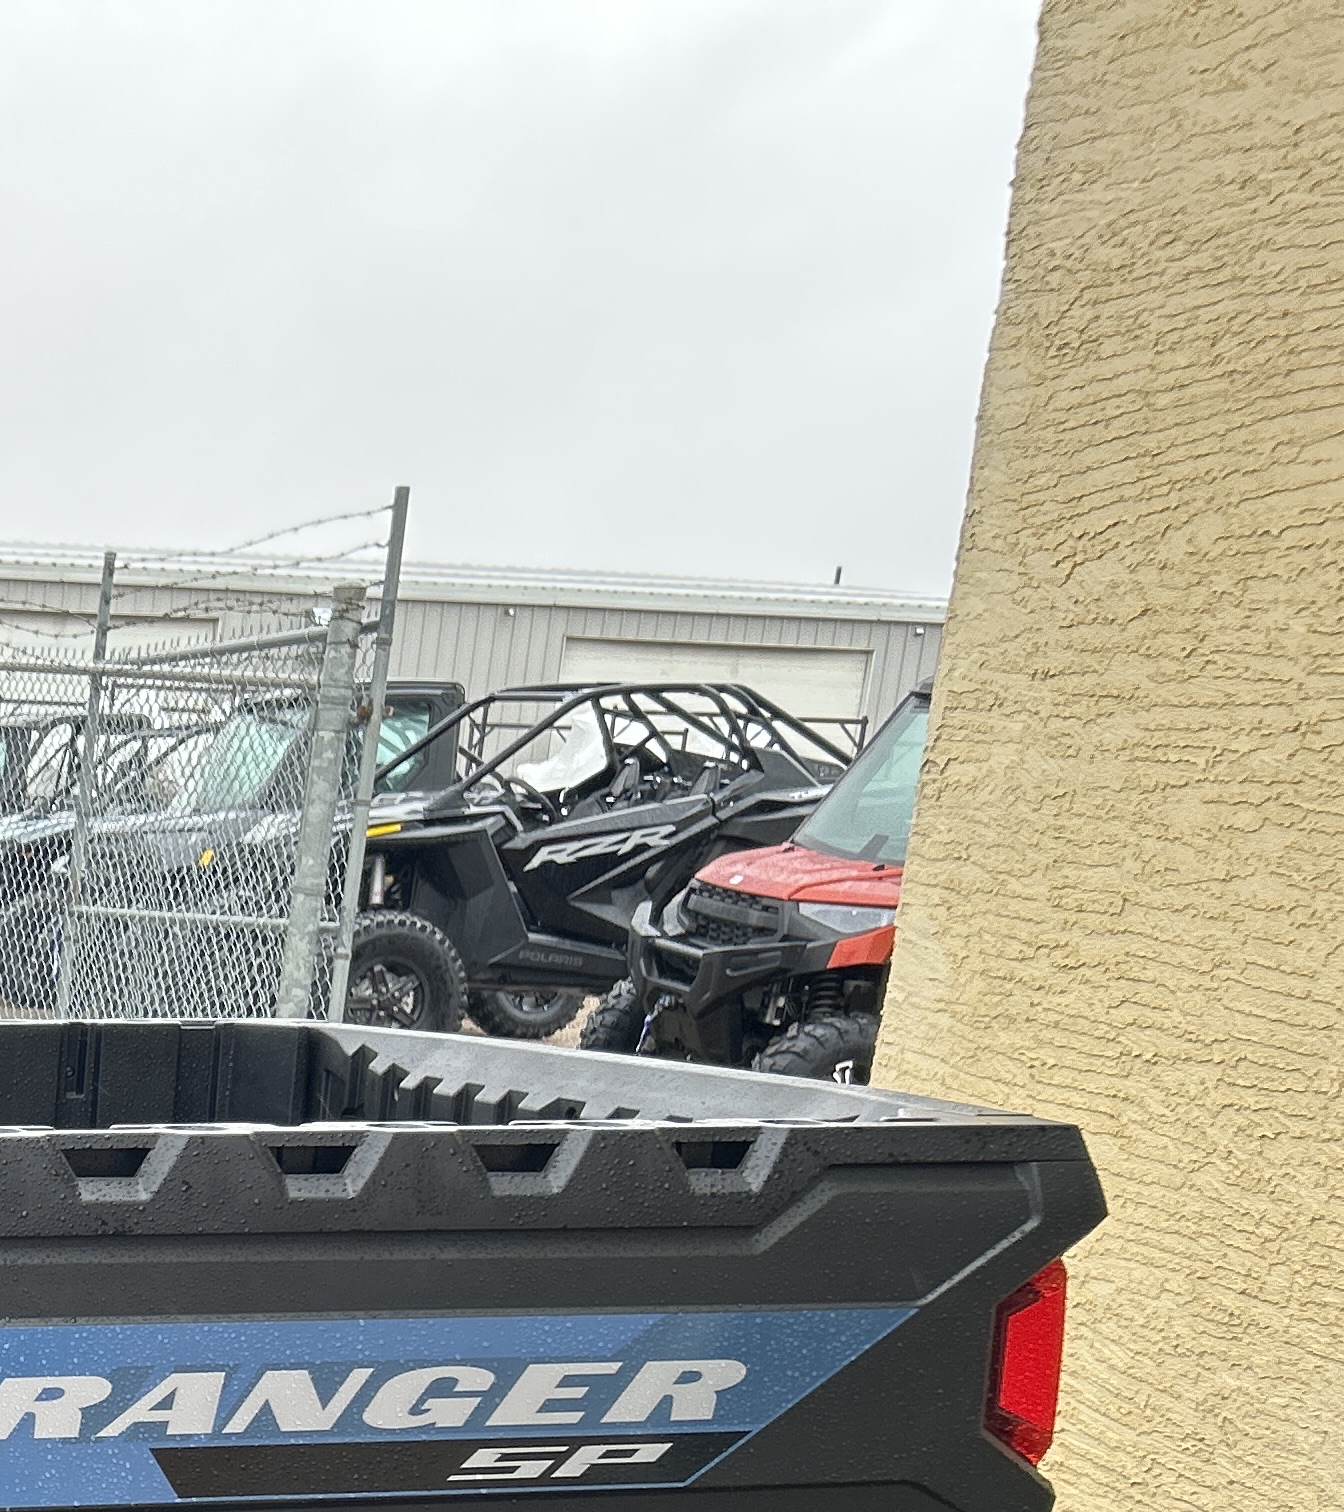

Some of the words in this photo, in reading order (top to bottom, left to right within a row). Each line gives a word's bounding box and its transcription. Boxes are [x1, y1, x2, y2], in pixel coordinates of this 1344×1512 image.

[522, 824, 677, 872] RZR
[518, 950, 584, 968] POLARIS
[446, 1443, 675, 1481] SP
